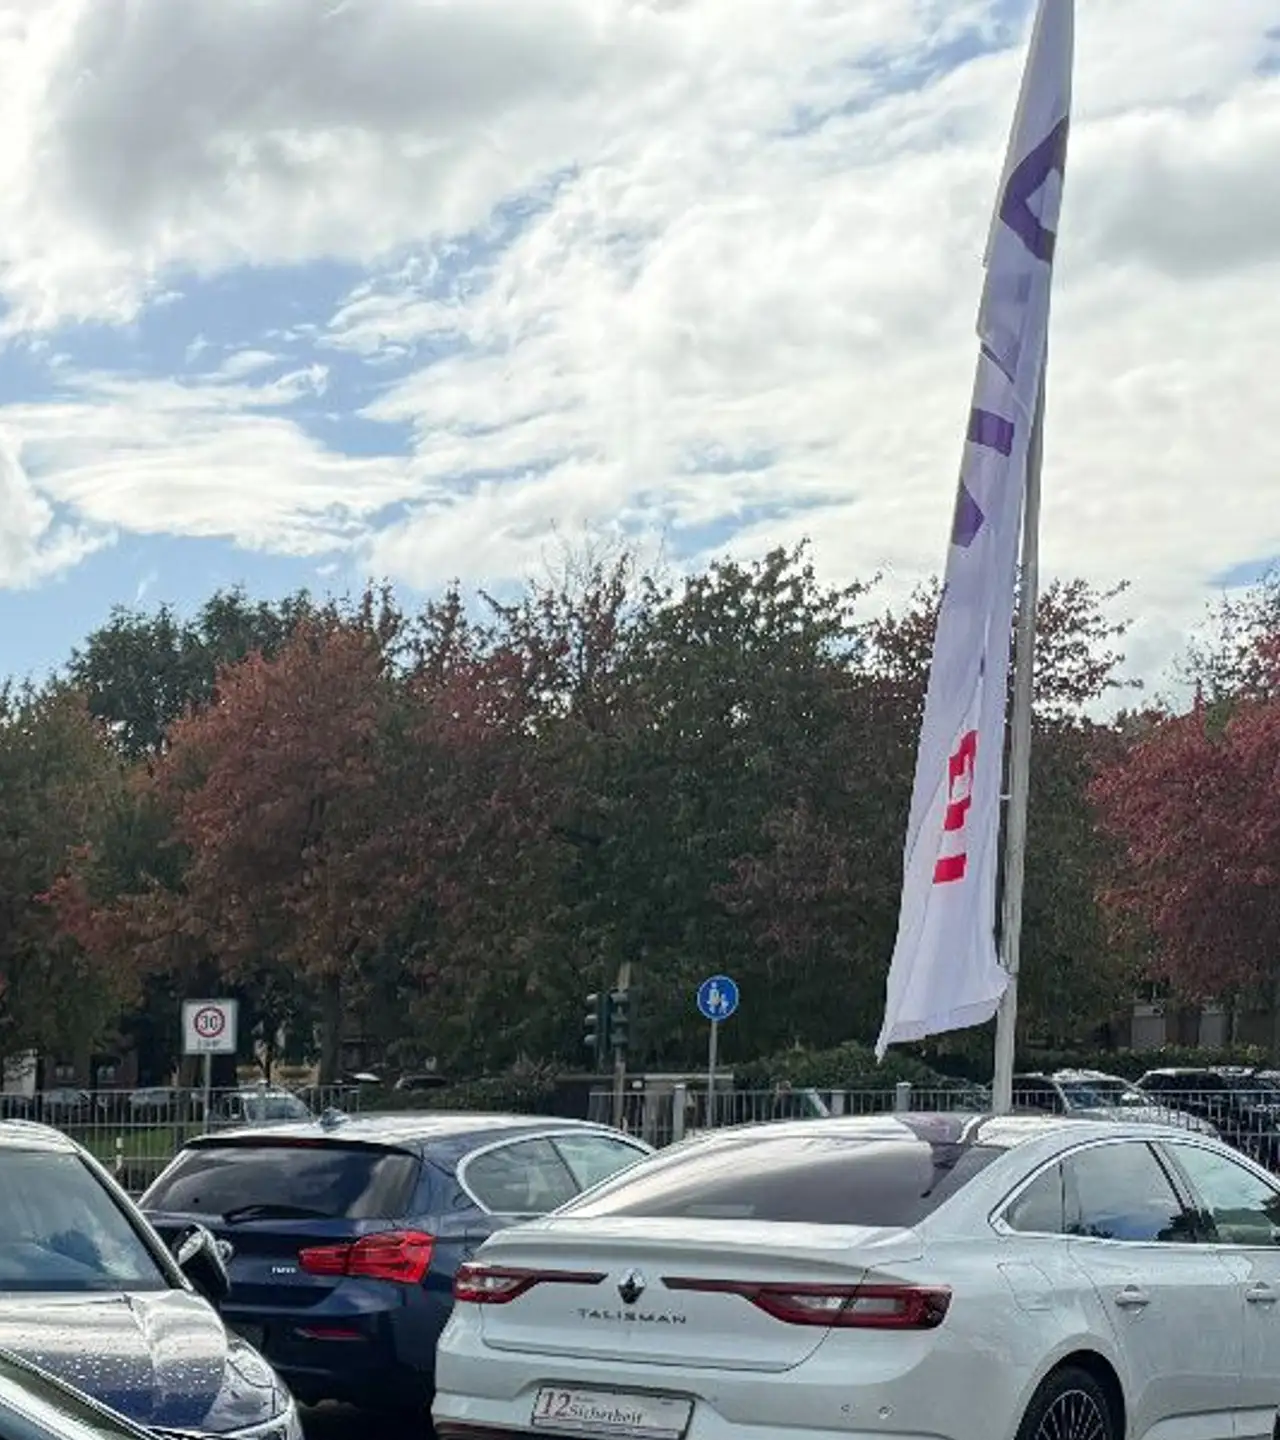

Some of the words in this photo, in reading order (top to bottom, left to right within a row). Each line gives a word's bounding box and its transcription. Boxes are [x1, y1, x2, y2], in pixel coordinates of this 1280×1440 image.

[201, 1015, 218, 1031] 30
[577, 1308, 686, 1324] TALISMAN
[543, 1391, 571, 1417] 12
